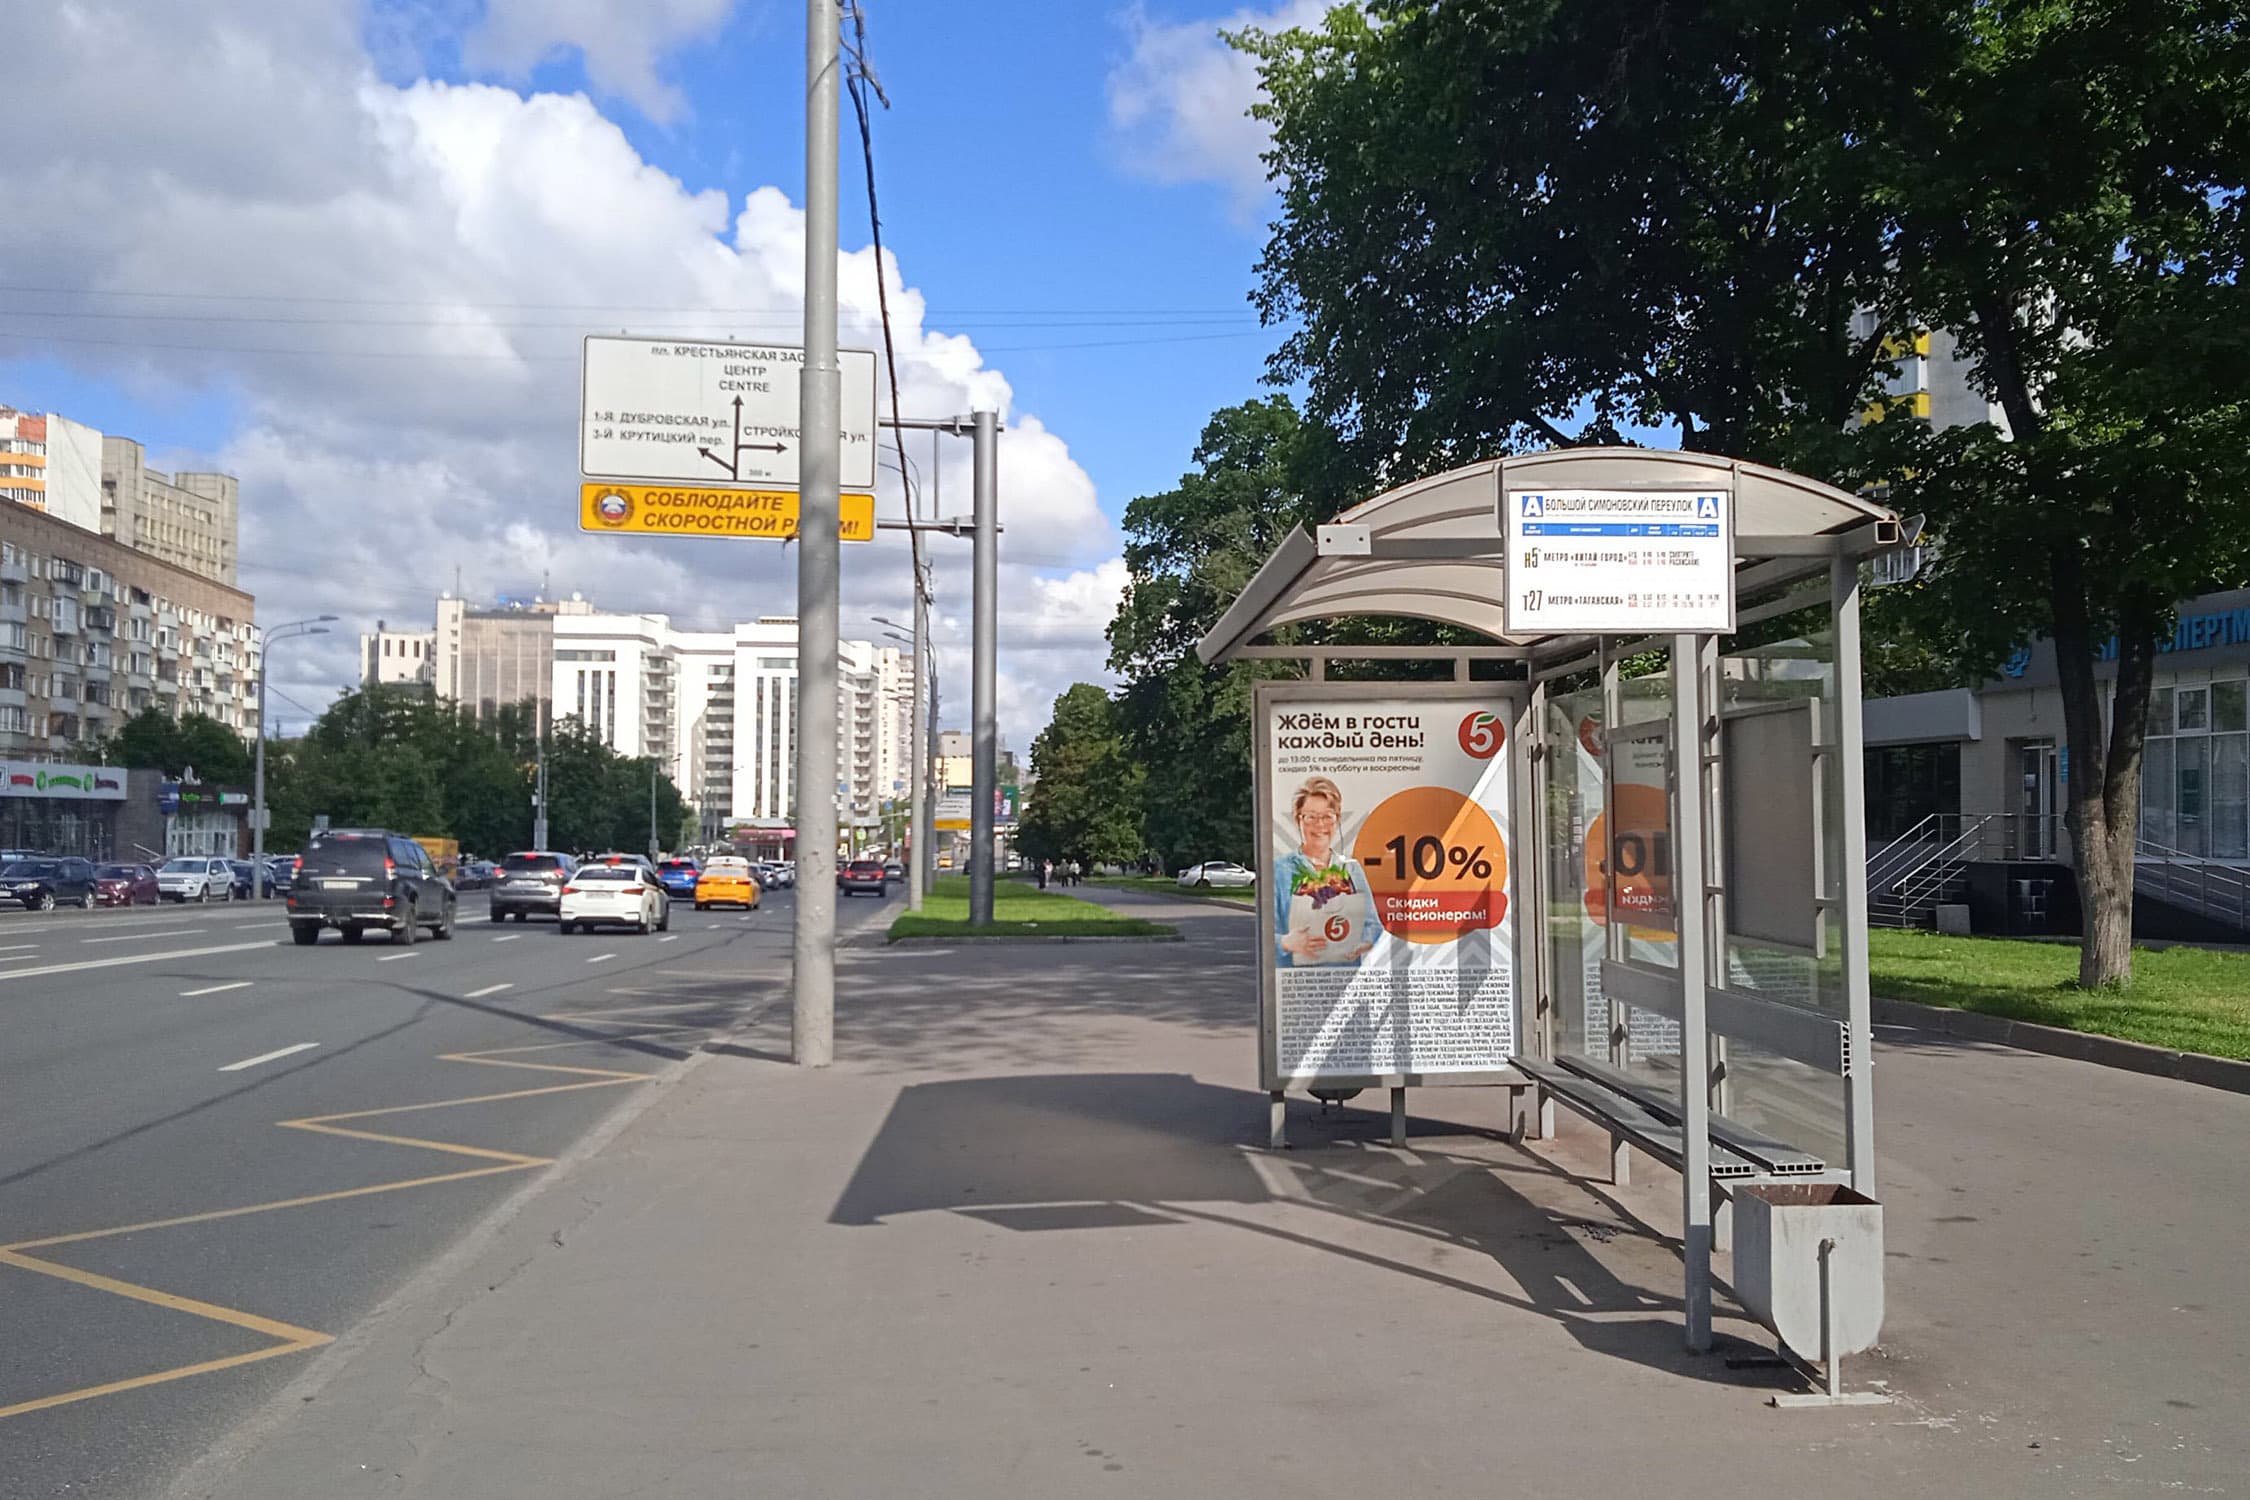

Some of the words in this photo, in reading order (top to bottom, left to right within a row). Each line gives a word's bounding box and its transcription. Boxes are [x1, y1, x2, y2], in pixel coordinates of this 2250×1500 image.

[674, 346, 777, 361] КРЕСТЬЯНСКАЯ
[724, 365, 767, 377] ЦЕНТР
[719, 380, 771, 392] CENTRE
[620, 412, 709, 426] ДУБРОВСКАЯ
[620, 430, 696, 443] КРУТИЦКИЙ
[644, 491, 783, 511] СОБЛЮДАЙТЕ
[1545, 497, 1586, 511] БОЛЬШОЙ
[1588, 497, 1649, 511] СИМОНОВСКИЙ
[1651, 499, 1693, 512] ПЕРЕУЛОК
[643, 512, 777, 531] СКОРОСТНОЙ
[1543, 552, 1569, 562] МЕТРО
[1548, 596, 1573, 605] МЕТРО
[1278, 713, 1339, 730] Ждём
[1346, 716, 1357, 729] в
[1363, 716, 1419, 729] гости
[1278, 731, 1363, 749] каждый
[1370, 731, 1424, 748] день!
[1318, 755, 1375, 764] понедельника
[1329, 764, 1361, 773] субботу
[1370, 764, 1420, 773] воскресенье
[1364, 835, 1492, 881] -10%
[1386, 897, 1439, 909] Скидки
[1386, 909, 1486, 923] пенсионерам!
